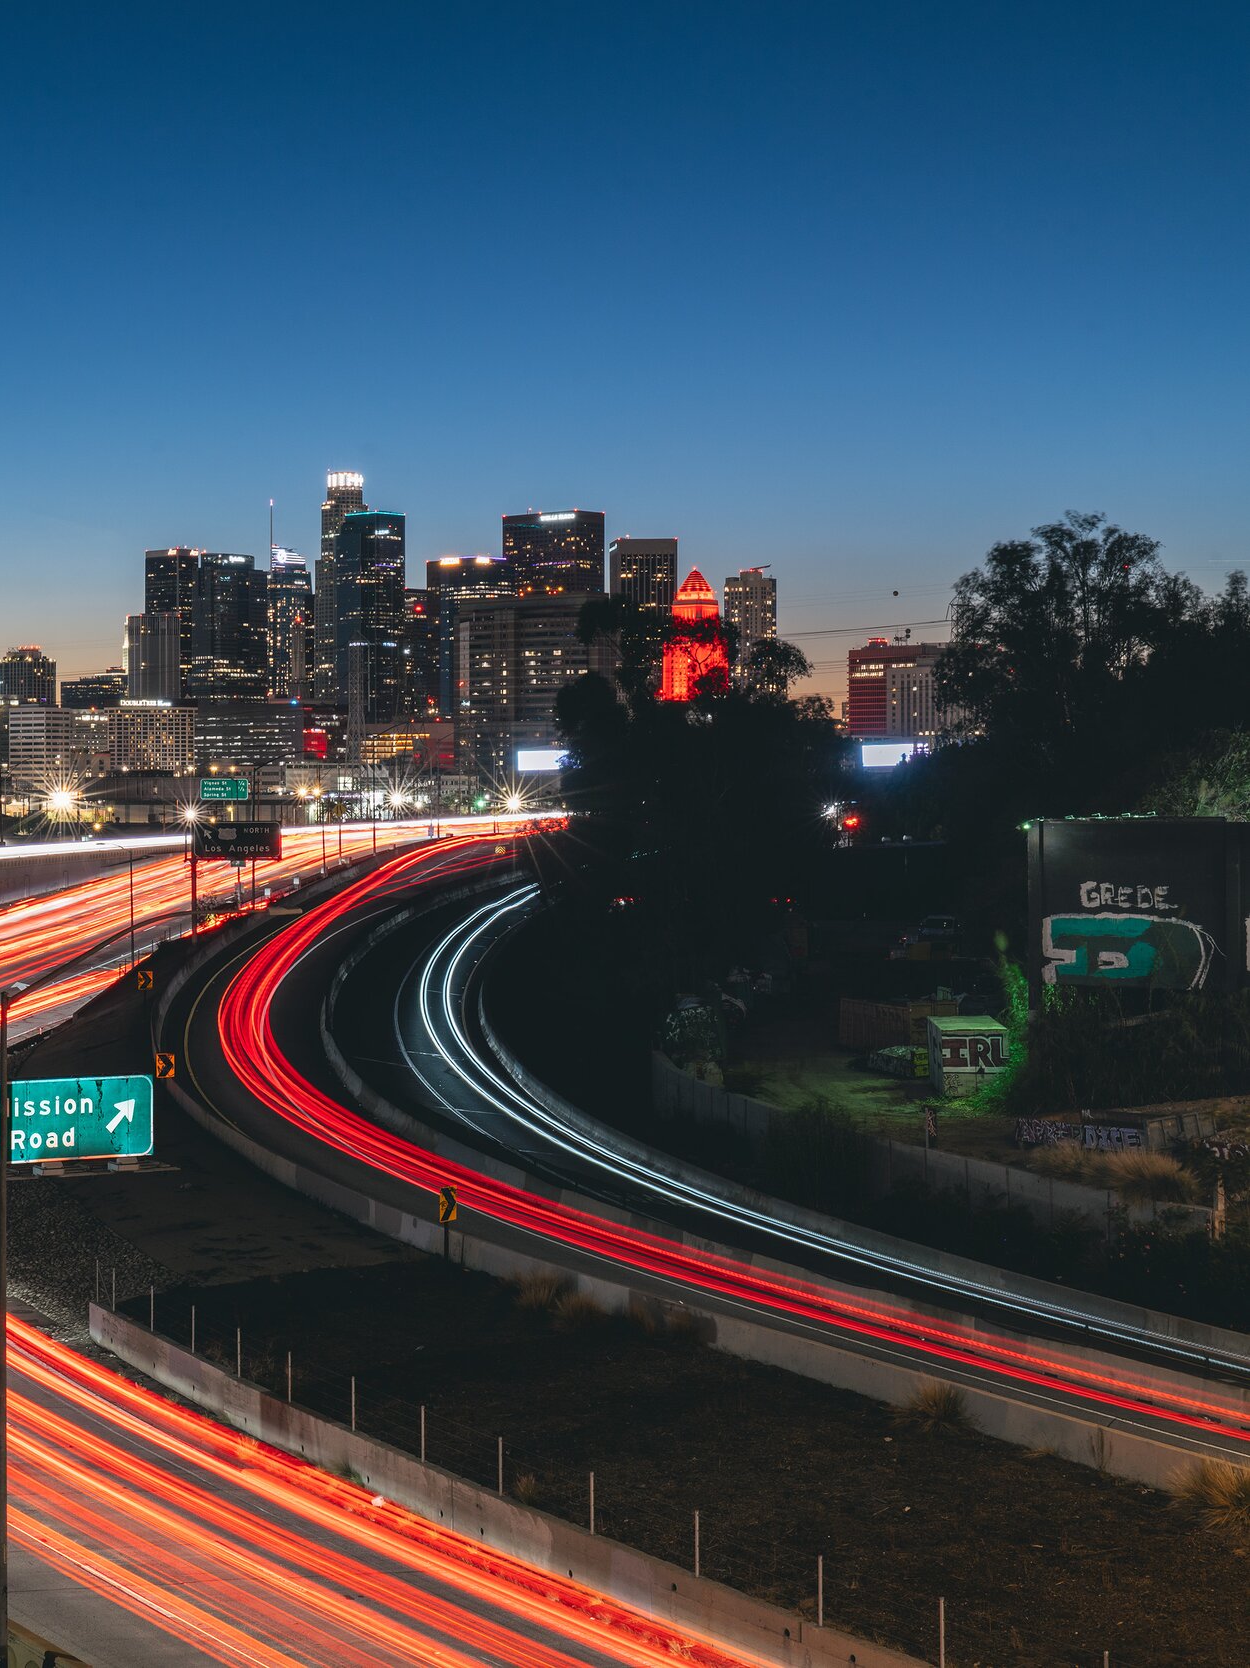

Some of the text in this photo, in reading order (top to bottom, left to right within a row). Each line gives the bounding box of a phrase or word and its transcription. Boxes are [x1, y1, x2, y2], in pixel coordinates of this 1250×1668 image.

[205, 844, 270, 855] Los Angeles
[11, 1126, 75, 1151] Road
